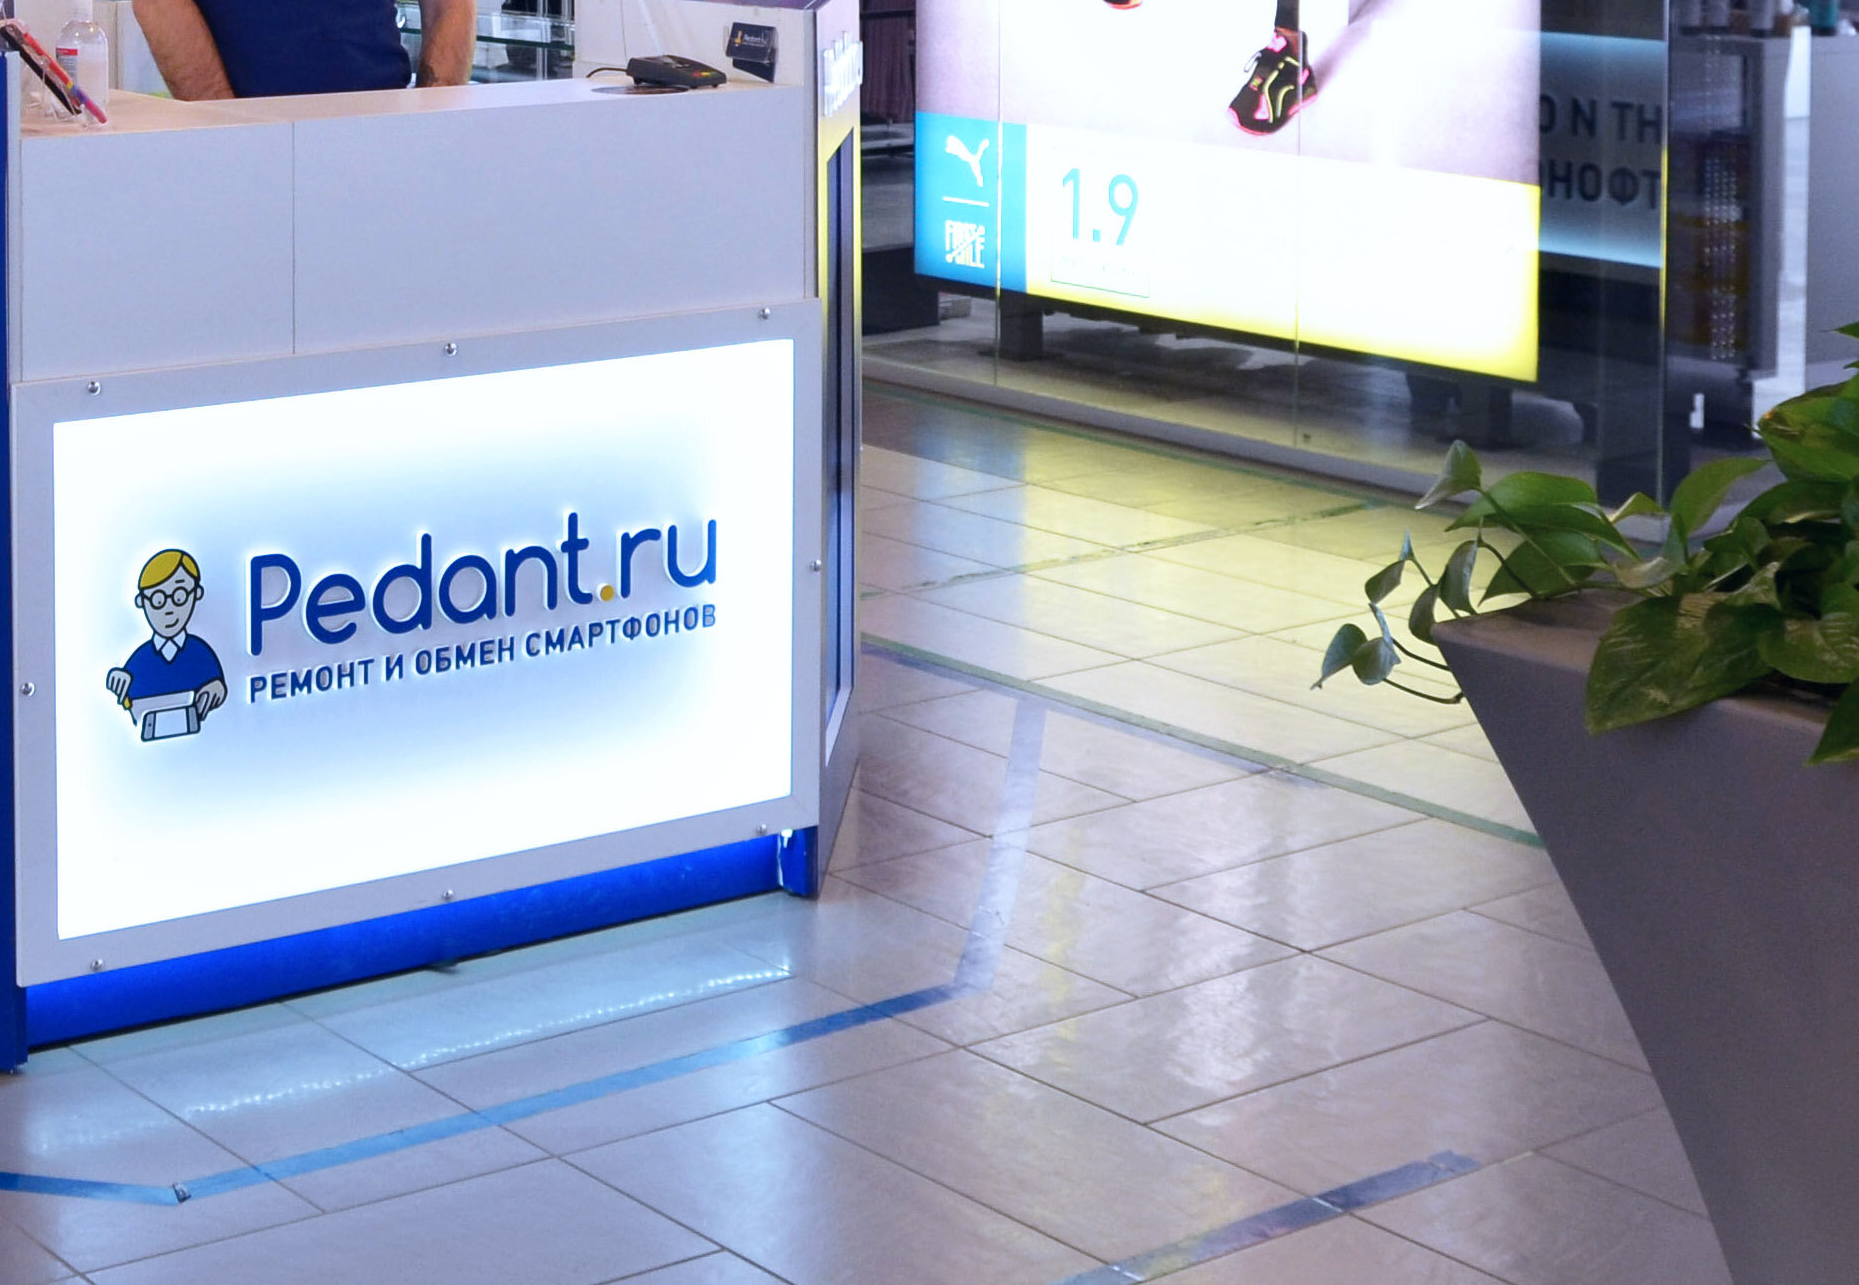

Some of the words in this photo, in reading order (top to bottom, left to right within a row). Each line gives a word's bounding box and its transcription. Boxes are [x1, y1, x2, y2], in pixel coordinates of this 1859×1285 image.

[1062, 168, 1139, 246] 1.9
[245, 512, 718, 656] Pedant.ru
[249, 657, 372, 704] РЕМОНТ
[385, 654, 404, 680] И
[414, 635, 515, 676] ОБМЕН
[525, 603, 718, 657] СМАРТФОНОВ
